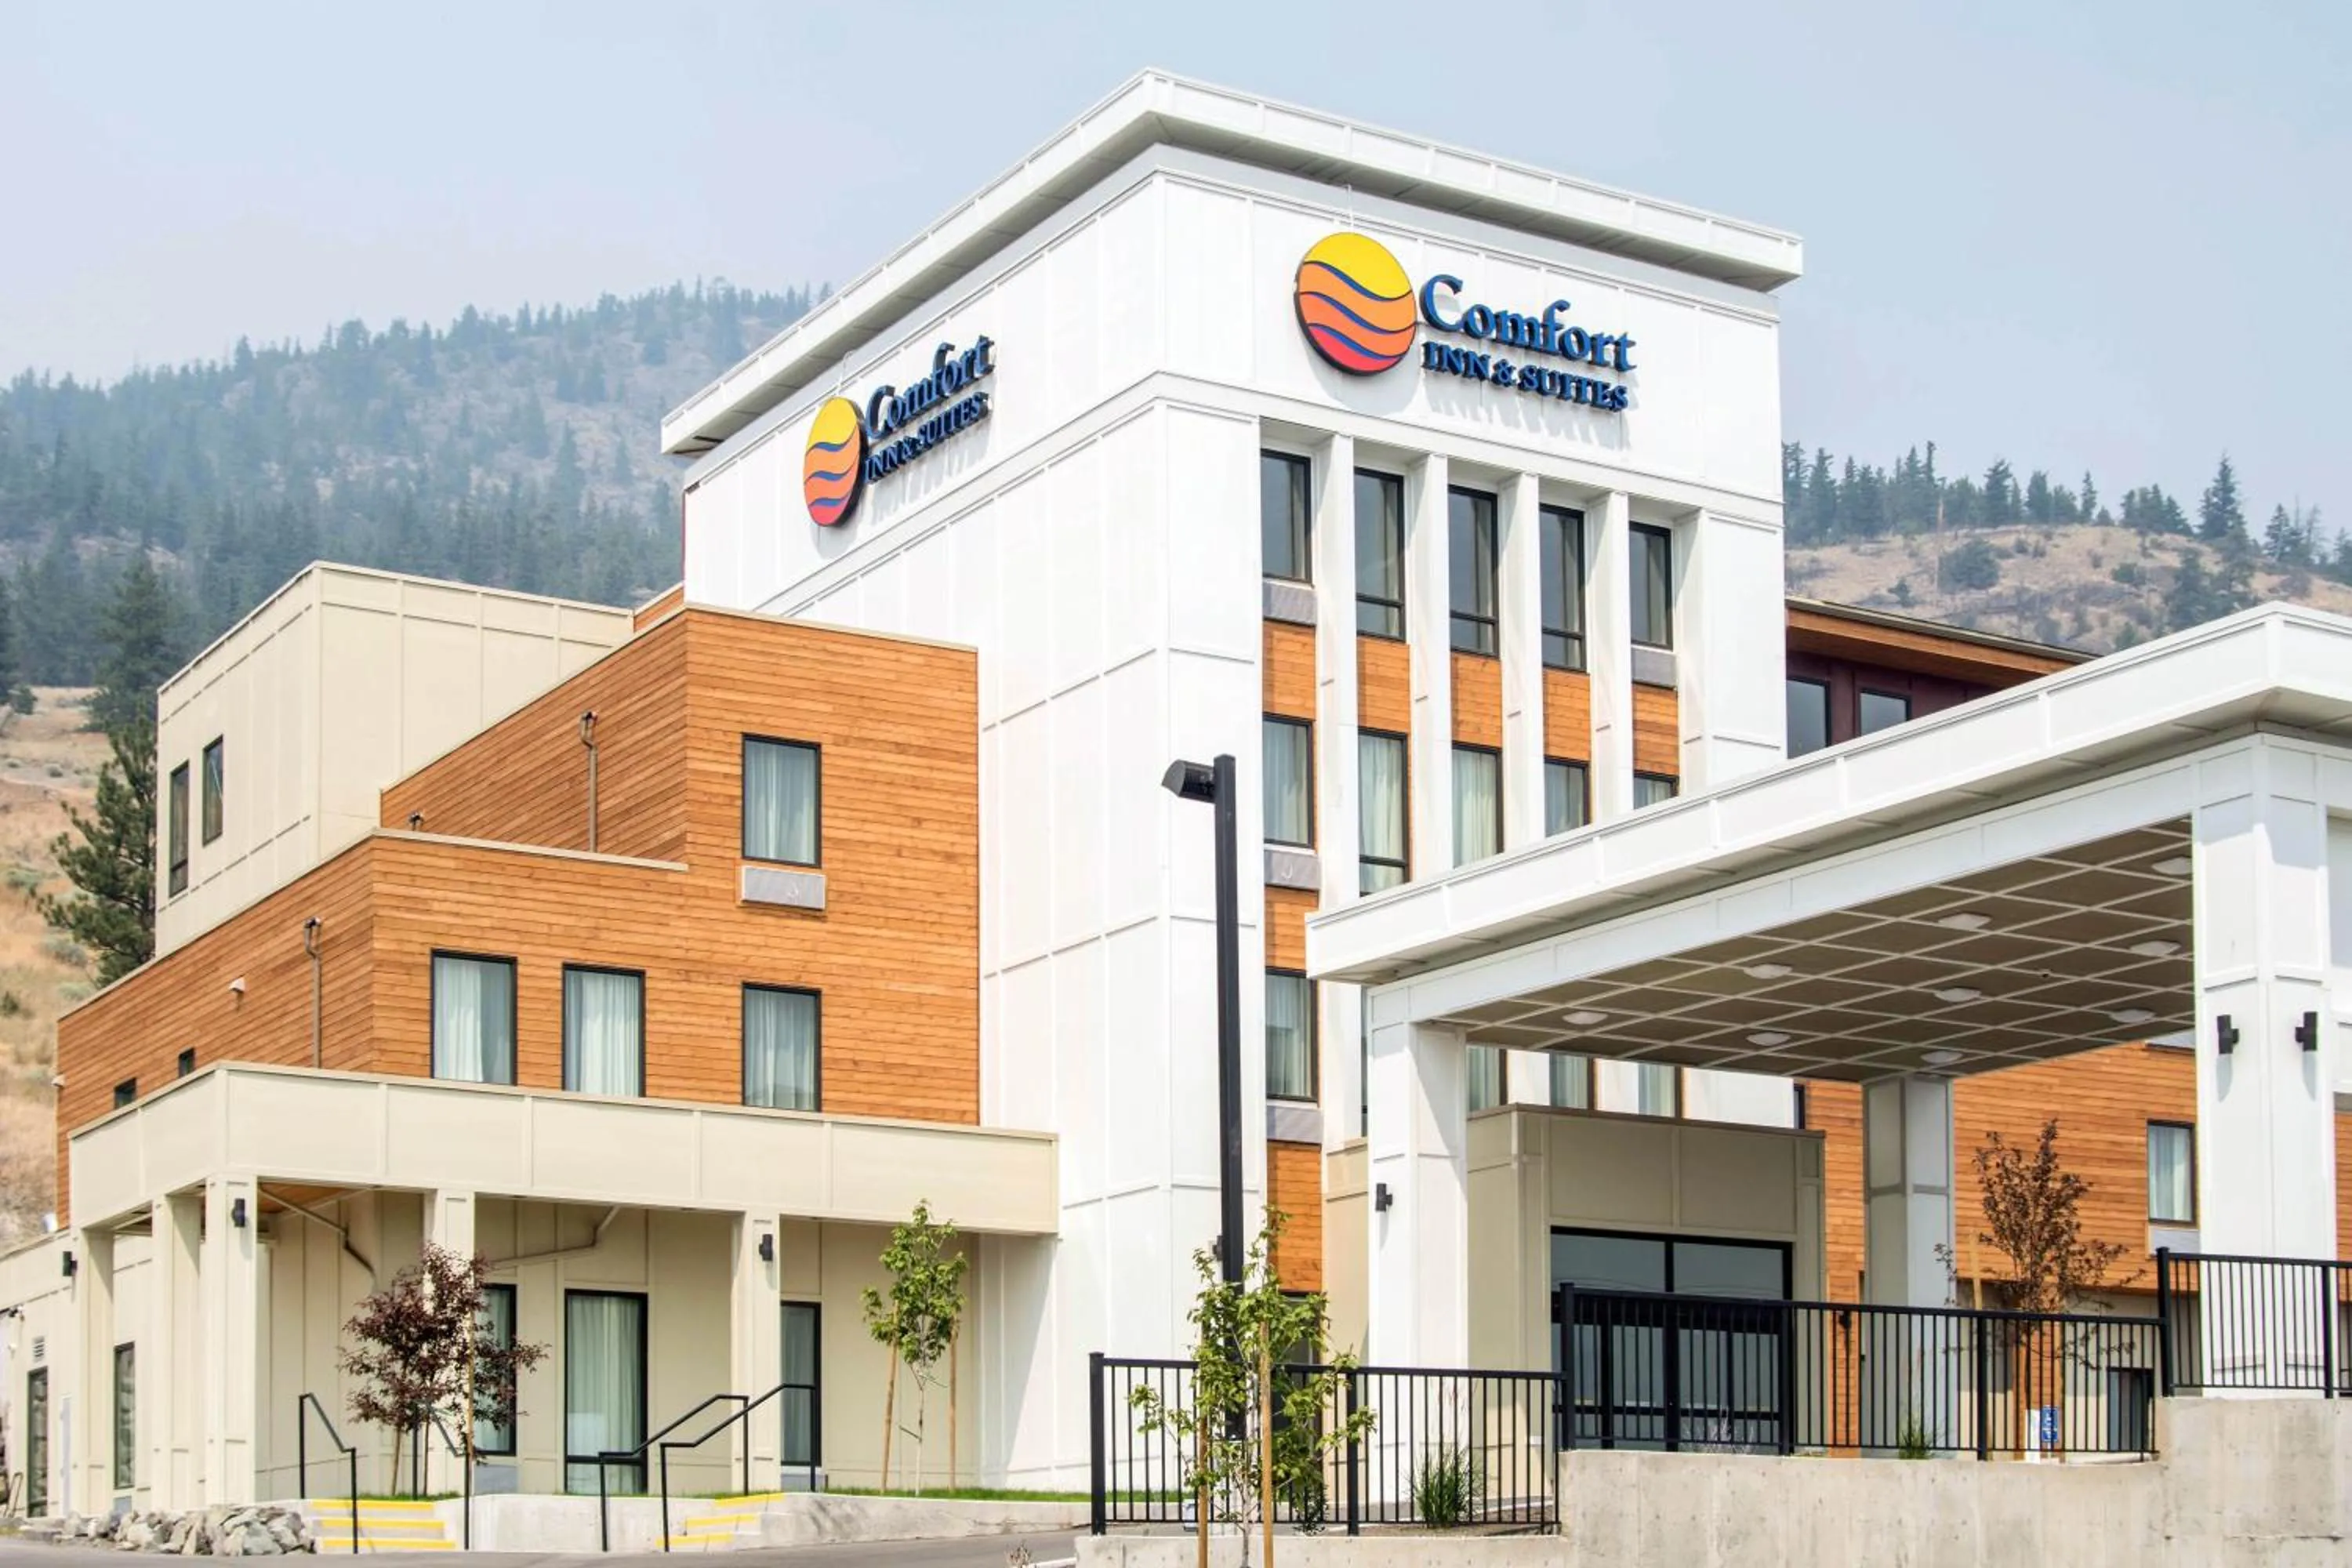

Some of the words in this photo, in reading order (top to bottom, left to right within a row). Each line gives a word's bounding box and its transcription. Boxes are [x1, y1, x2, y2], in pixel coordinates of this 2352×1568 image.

[1420, 274, 1637, 372] Comfort
[865, 335, 994, 439] Comfort
[1422, 341, 1490, 380] INN
[1494, 358, 1516, 387] &
[1519, 364, 1629, 412] SUITES
[865, 441, 902, 483] INN
[918, 391, 989, 449] SUITES
